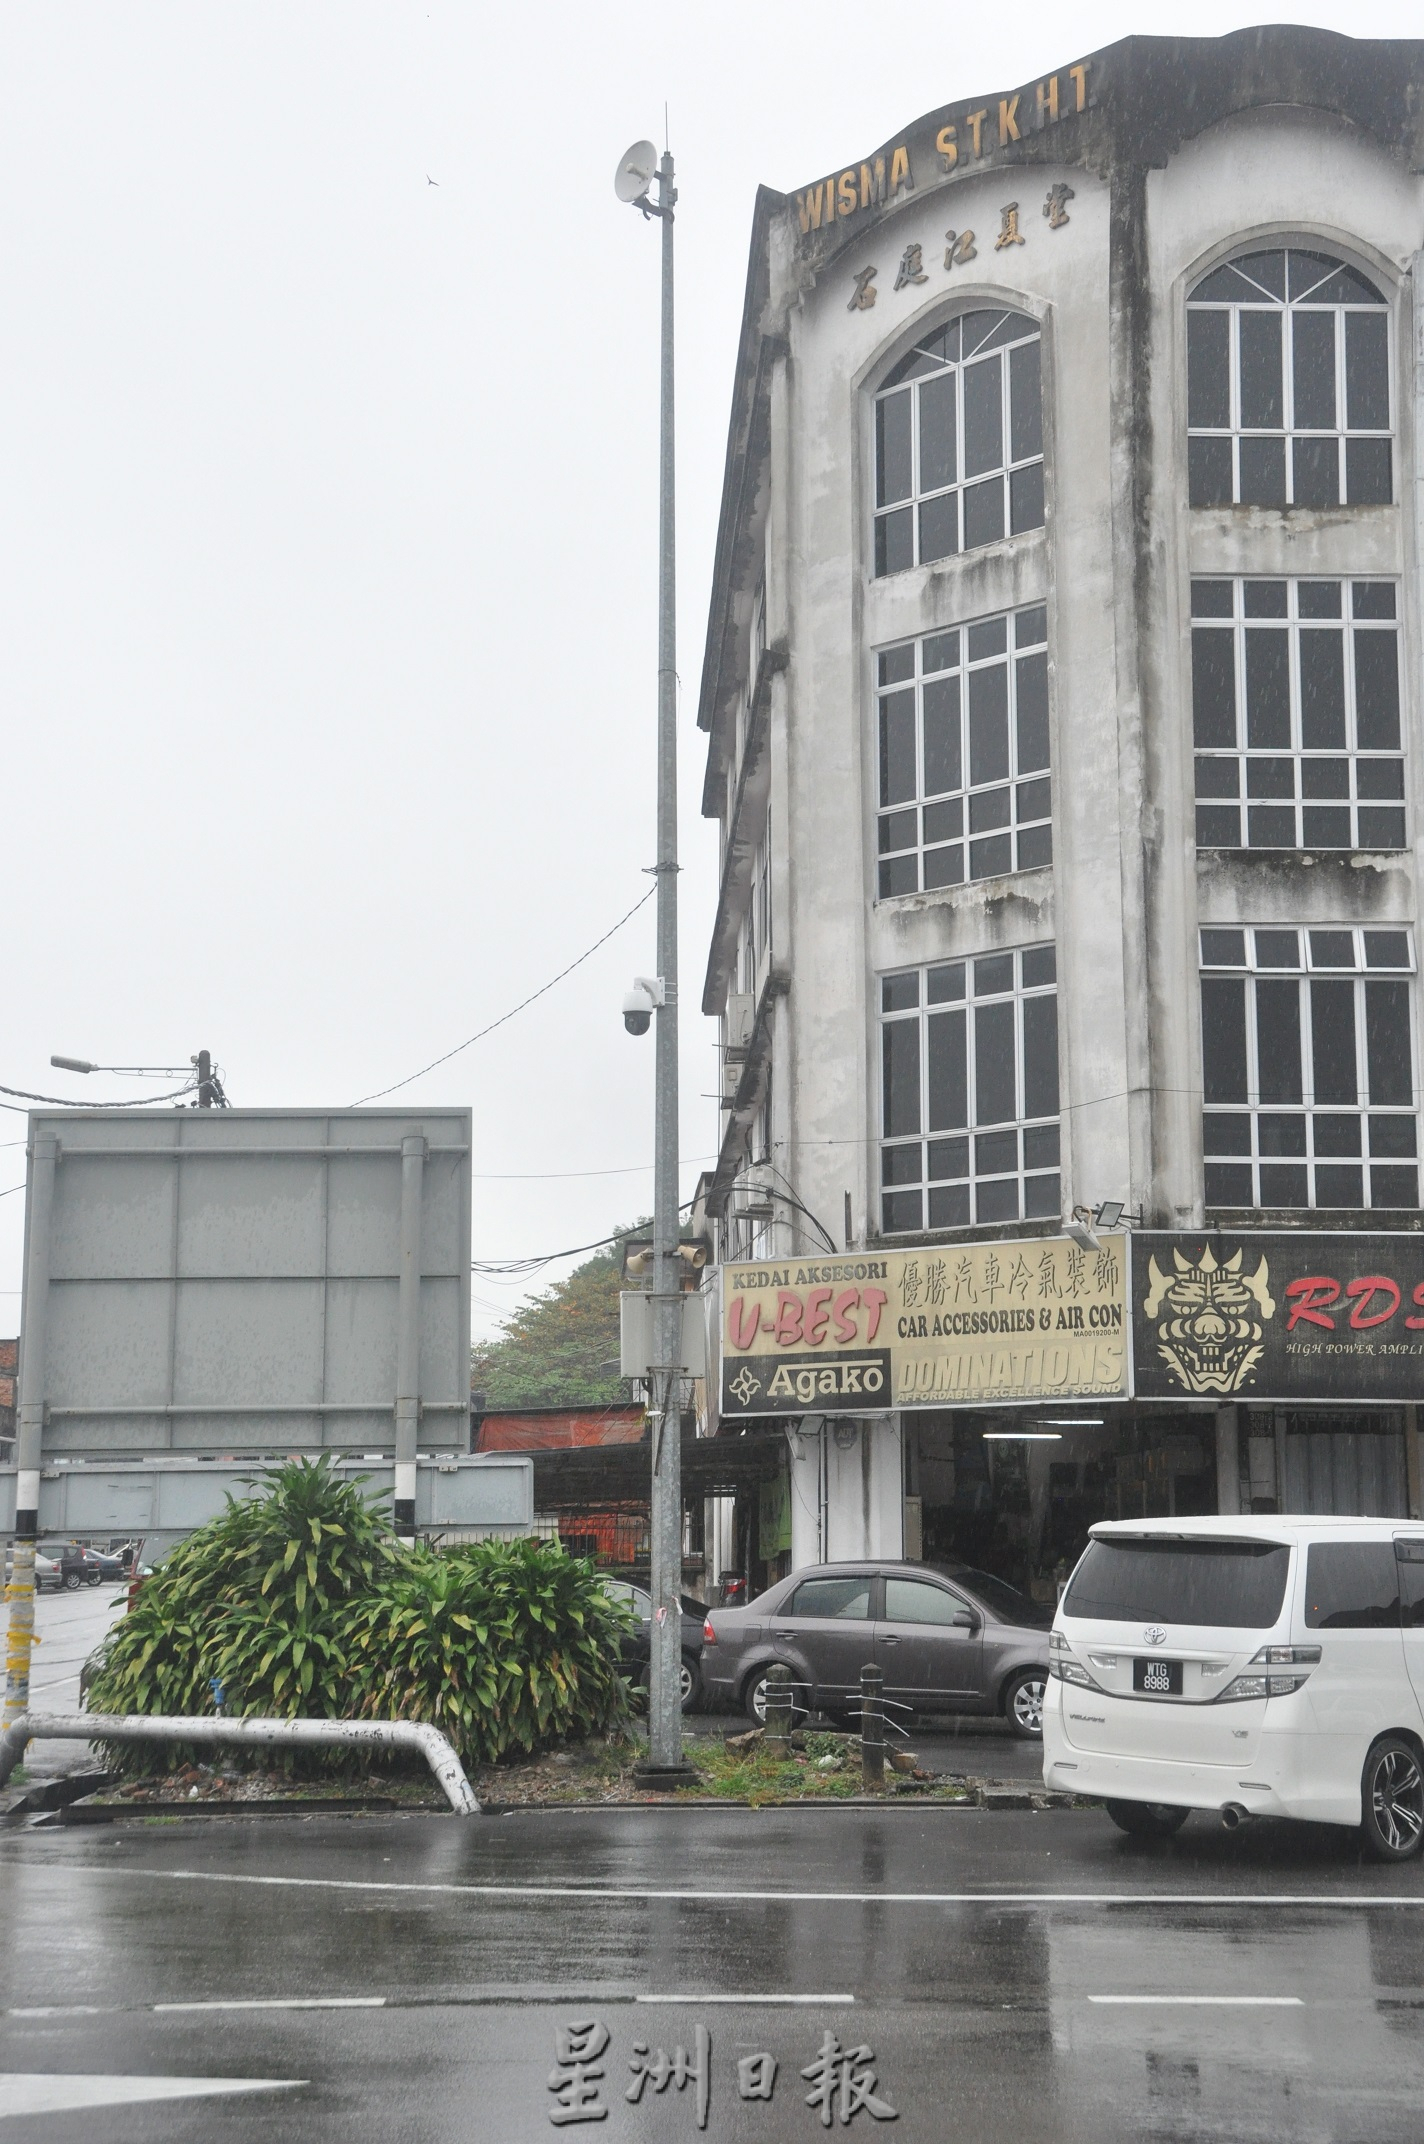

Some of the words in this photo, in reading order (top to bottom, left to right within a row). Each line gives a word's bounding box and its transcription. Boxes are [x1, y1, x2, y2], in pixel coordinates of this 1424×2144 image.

[797, 145, 915, 235] WISMA
[846, 182, 1075, 311] 石庭江夏堂
[732, 1269, 790, 1289] KEDAI
[794, 1261, 888, 1285] AKSESORI
[898, 1246, 1119, 1308] 優勝汽車冷氣裝飾
[729, 1287, 888, 1350] U-BEST
[897, 1314, 928, 1339] CAR
[931, 1308, 1035, 1337] ACCESSORIES
[1039, 1307, 1052, 1330] &
[1055, 1305, 1085, 1330] AIR
[1089, 1303, 1123, 1328] CON
[1073, 1328, 1120, 1338] MA0019200-M
[899, 1342, 1123, 1393] DOMINATIONS
[1285, 1343, 1323, 1357] HIGH
[1325, 1343, 1377, 1356] POWER
[767, 1359, 884, 1403] Agako
[897, 1388, 980, 1403] AFFORDABLE
[983, 1385, 1069, 1399] EXCELLENCE
[1072, 1383, 1121, 1396] SOUND
[1143, 1676, 1170, 1691] 8988
[1147, 1661, 1168, 1677] WTG
